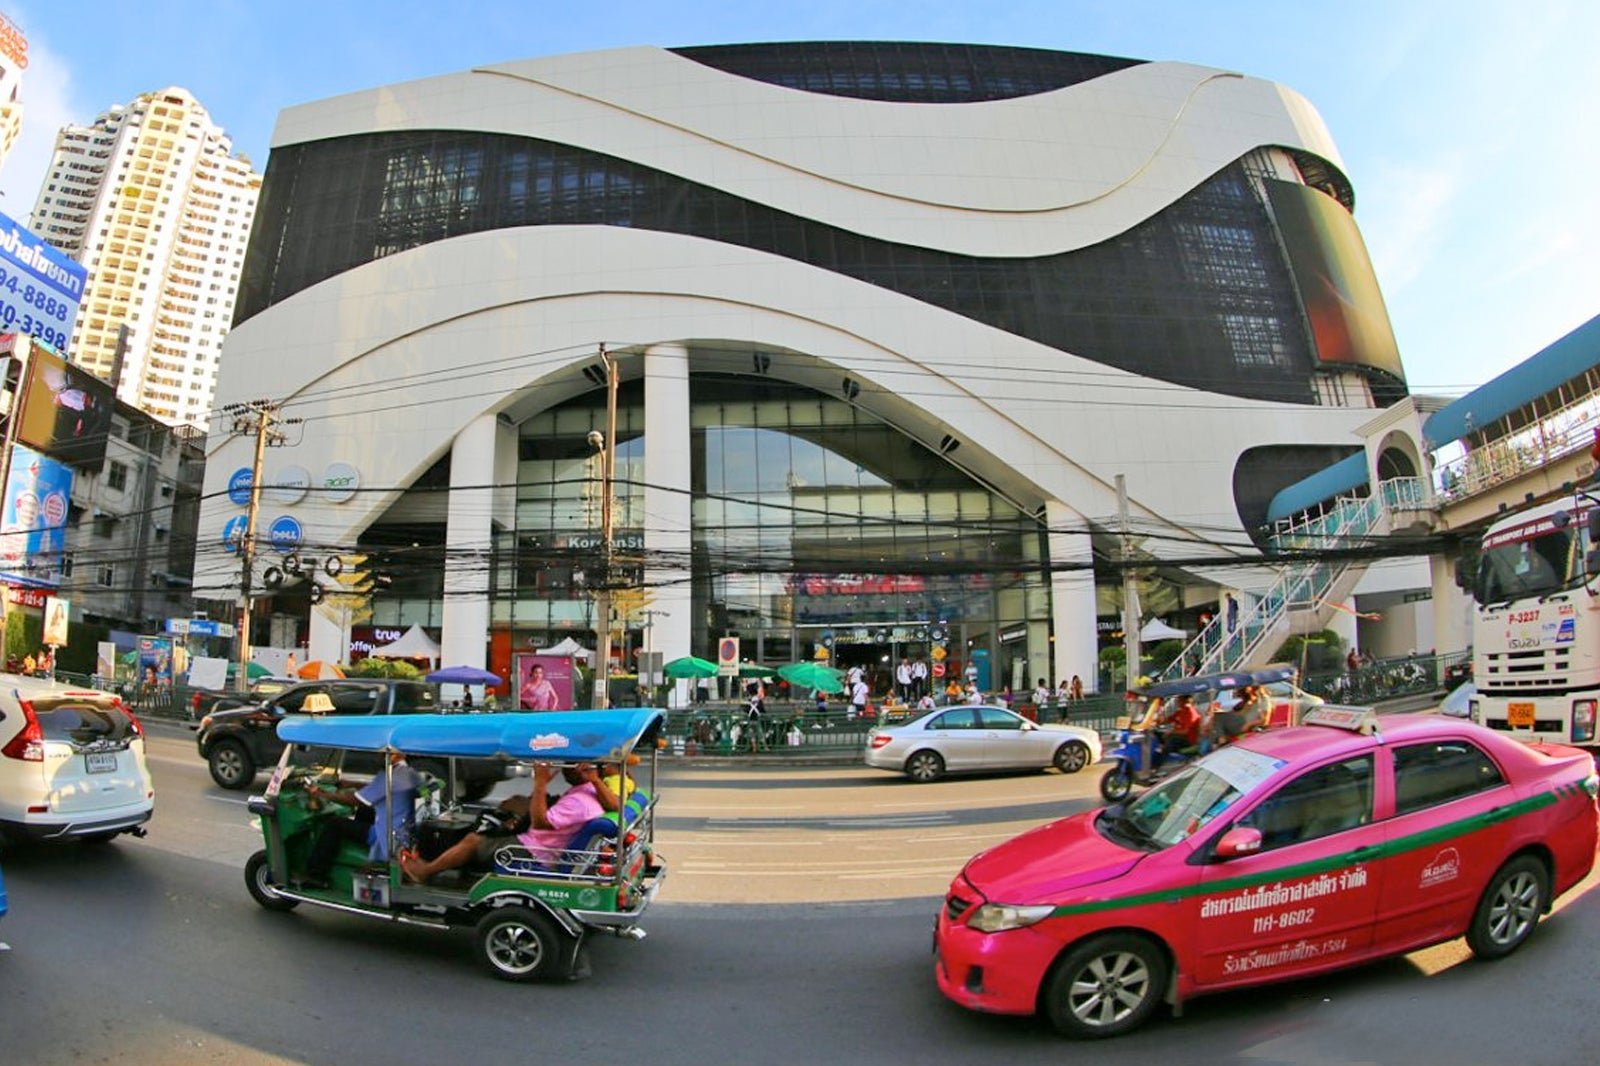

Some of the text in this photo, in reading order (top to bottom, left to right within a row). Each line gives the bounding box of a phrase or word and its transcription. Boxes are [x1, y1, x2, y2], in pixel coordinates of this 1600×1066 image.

[0, 301, 66, 350] 0-3398
[272, 530, 297, 541] DELL
[1508, 610, 1540, 625] P-3237
[374, 628, 401, 640] true
[1509, 638, 1540, 650] ISUZU
